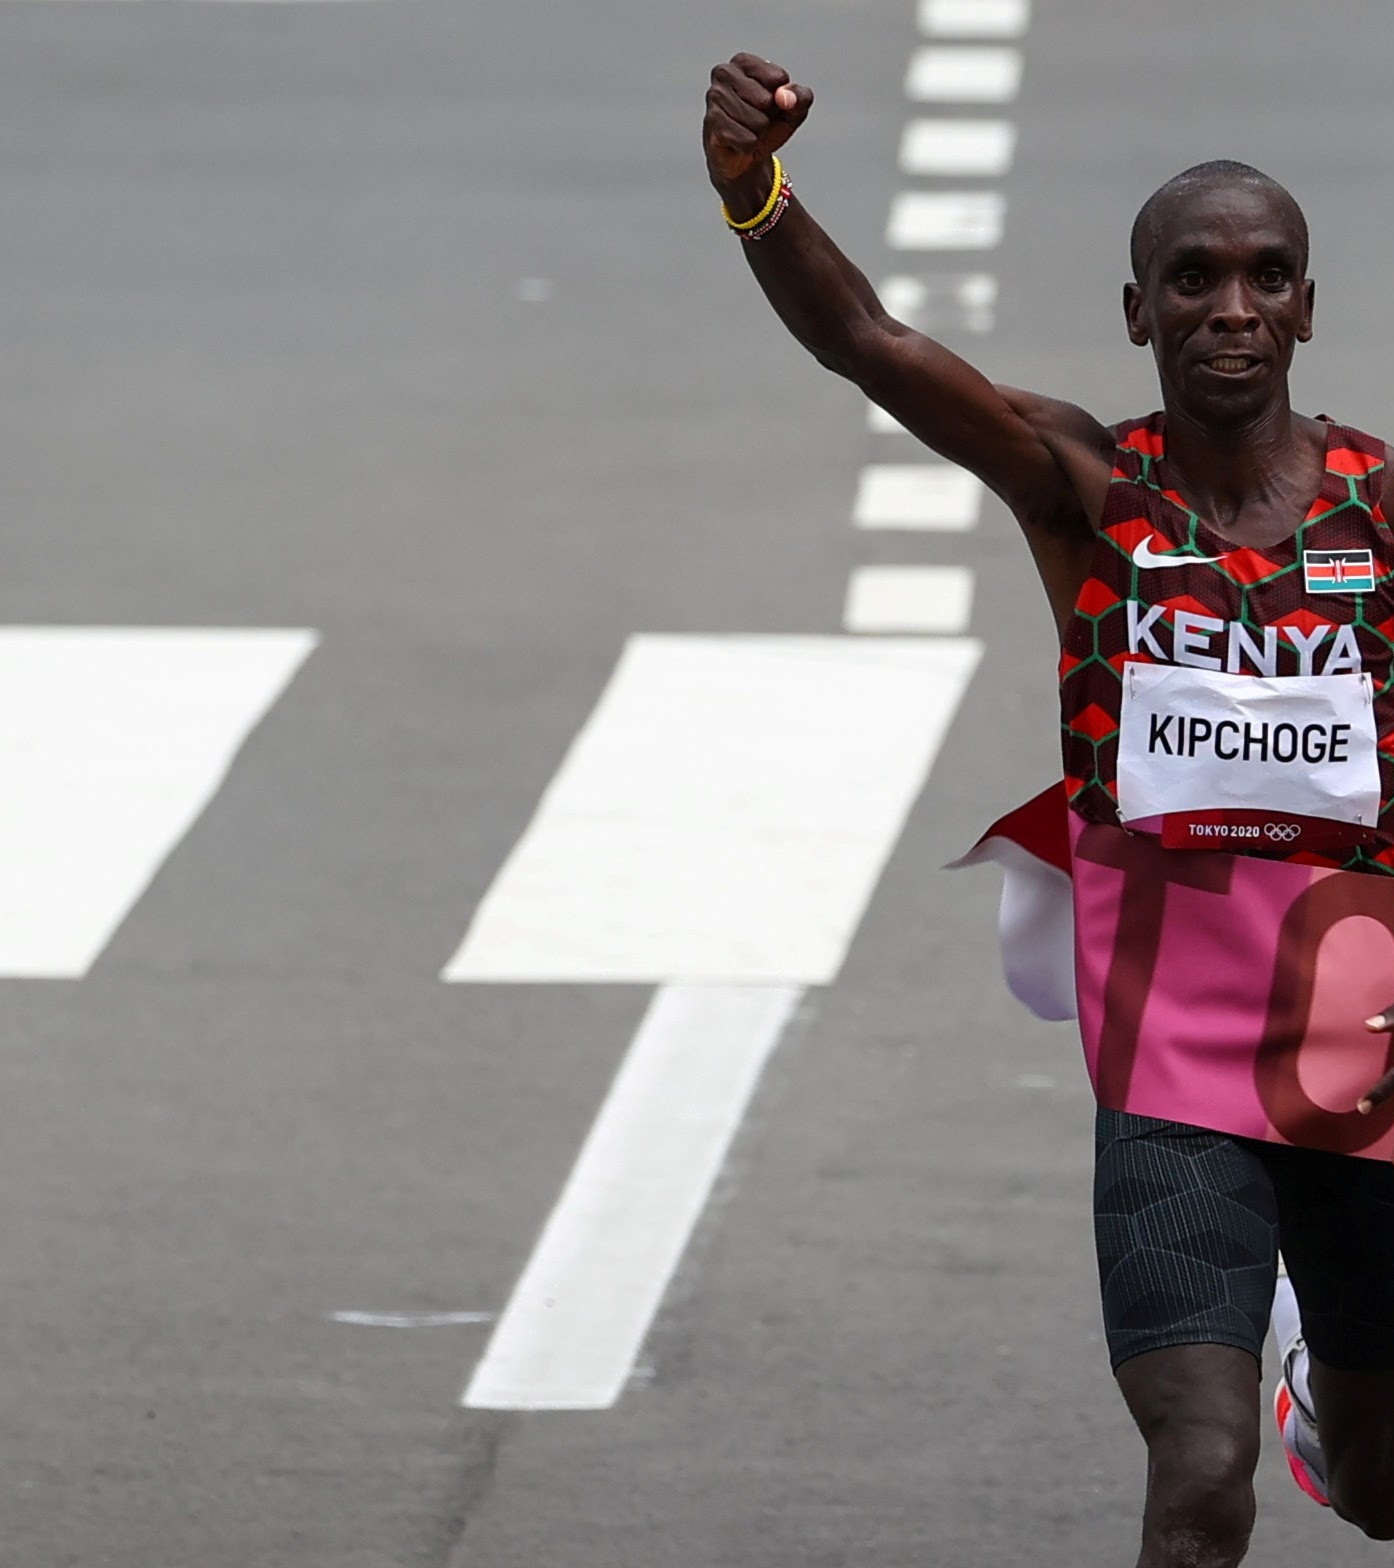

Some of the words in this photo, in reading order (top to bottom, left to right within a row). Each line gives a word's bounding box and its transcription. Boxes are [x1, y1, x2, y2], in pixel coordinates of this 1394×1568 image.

[1126, 599, 1363, 678] KENYA
[1147, 713, 1352, 763] KIPCHOGE
[1188, 824, 1229, 837] TOKYO
[1230, 825, 1260, 838] 2020
